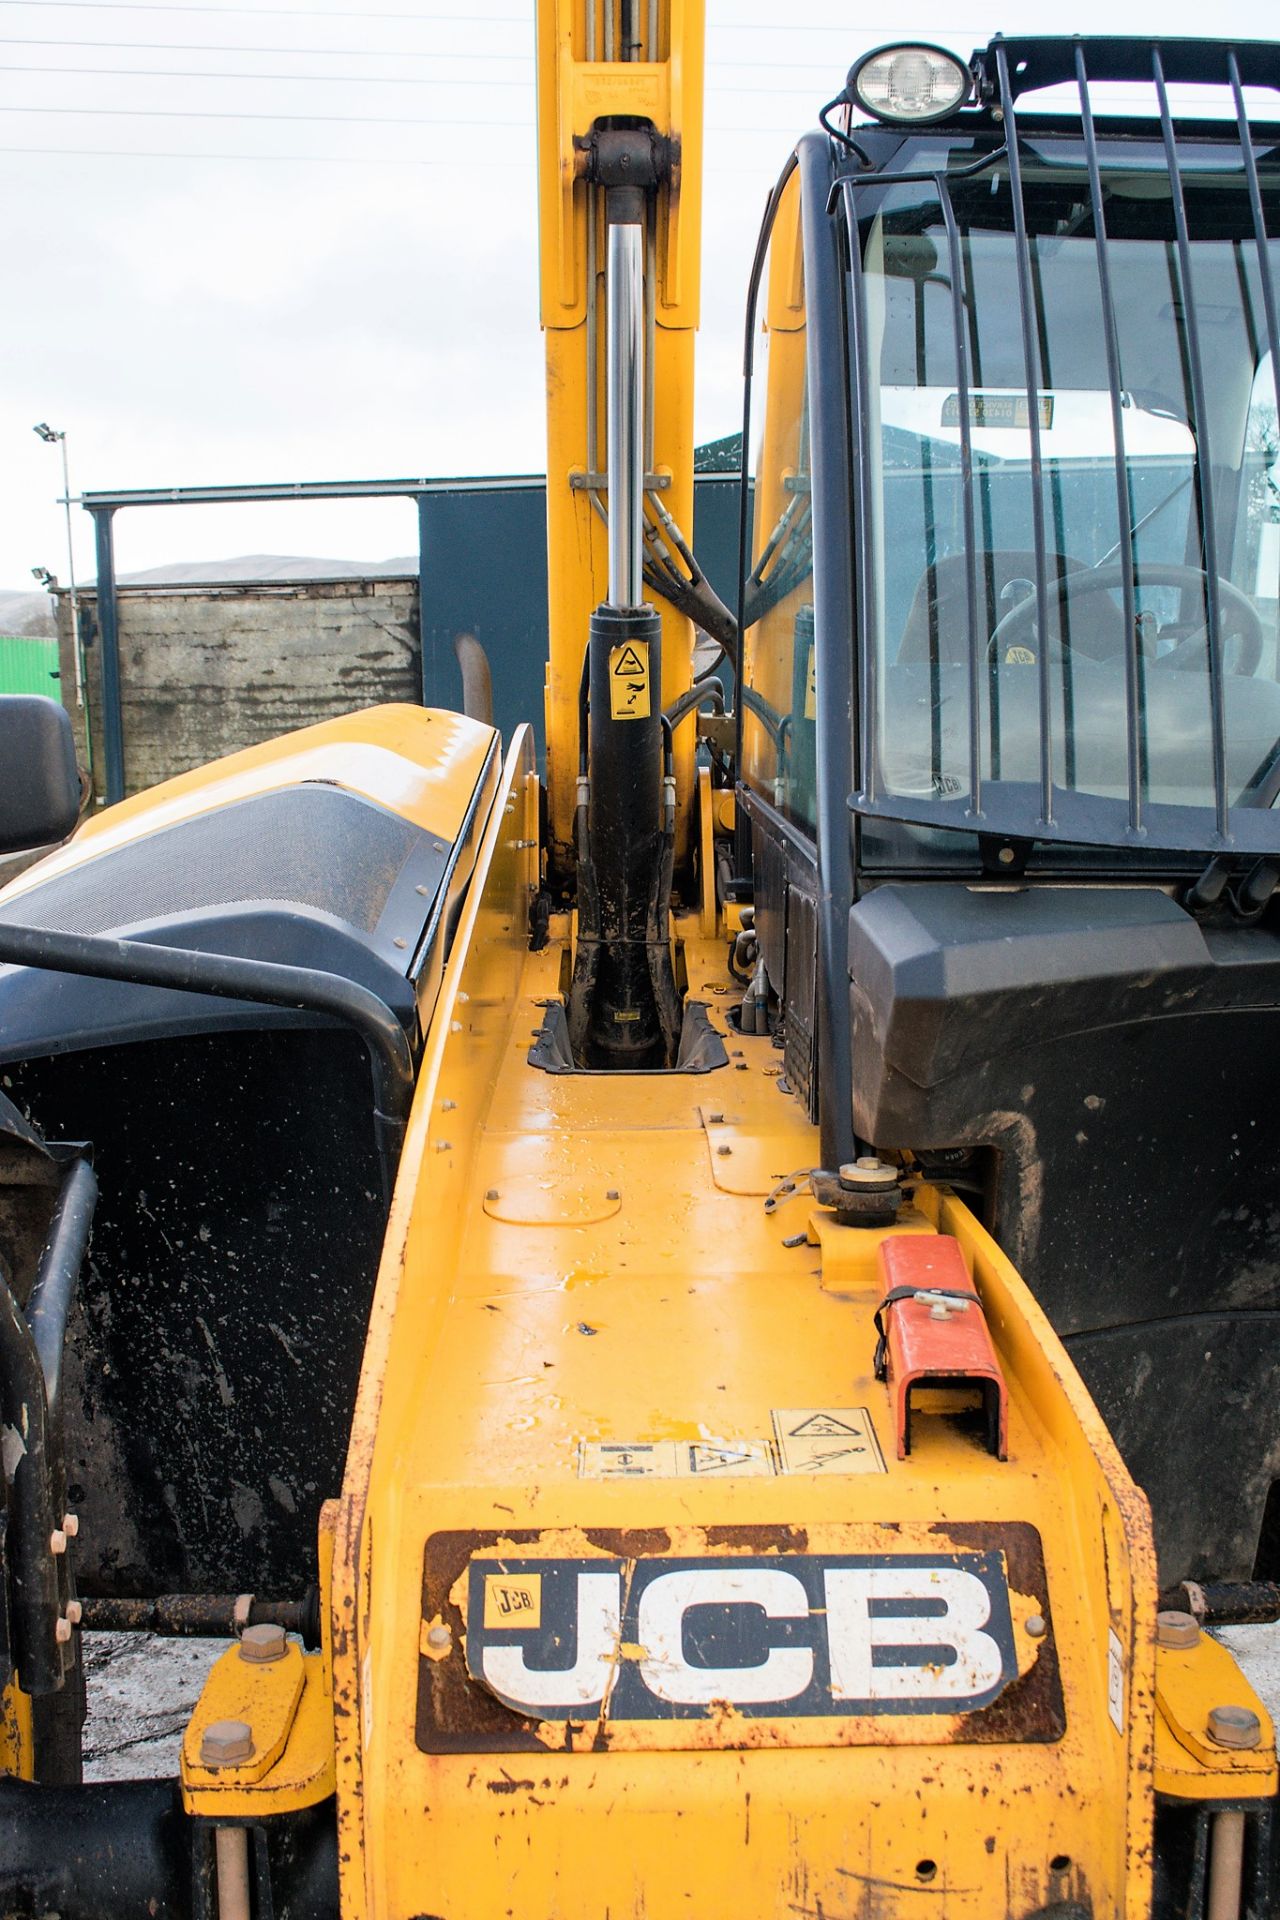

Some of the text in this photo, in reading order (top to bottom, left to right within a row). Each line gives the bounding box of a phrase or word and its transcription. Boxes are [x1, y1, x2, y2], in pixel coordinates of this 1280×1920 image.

[937, 777, 959, 794] JCB
[500, 1589, 531, 1613] JCB
[482, 1567, 1003, 1708] JCB
